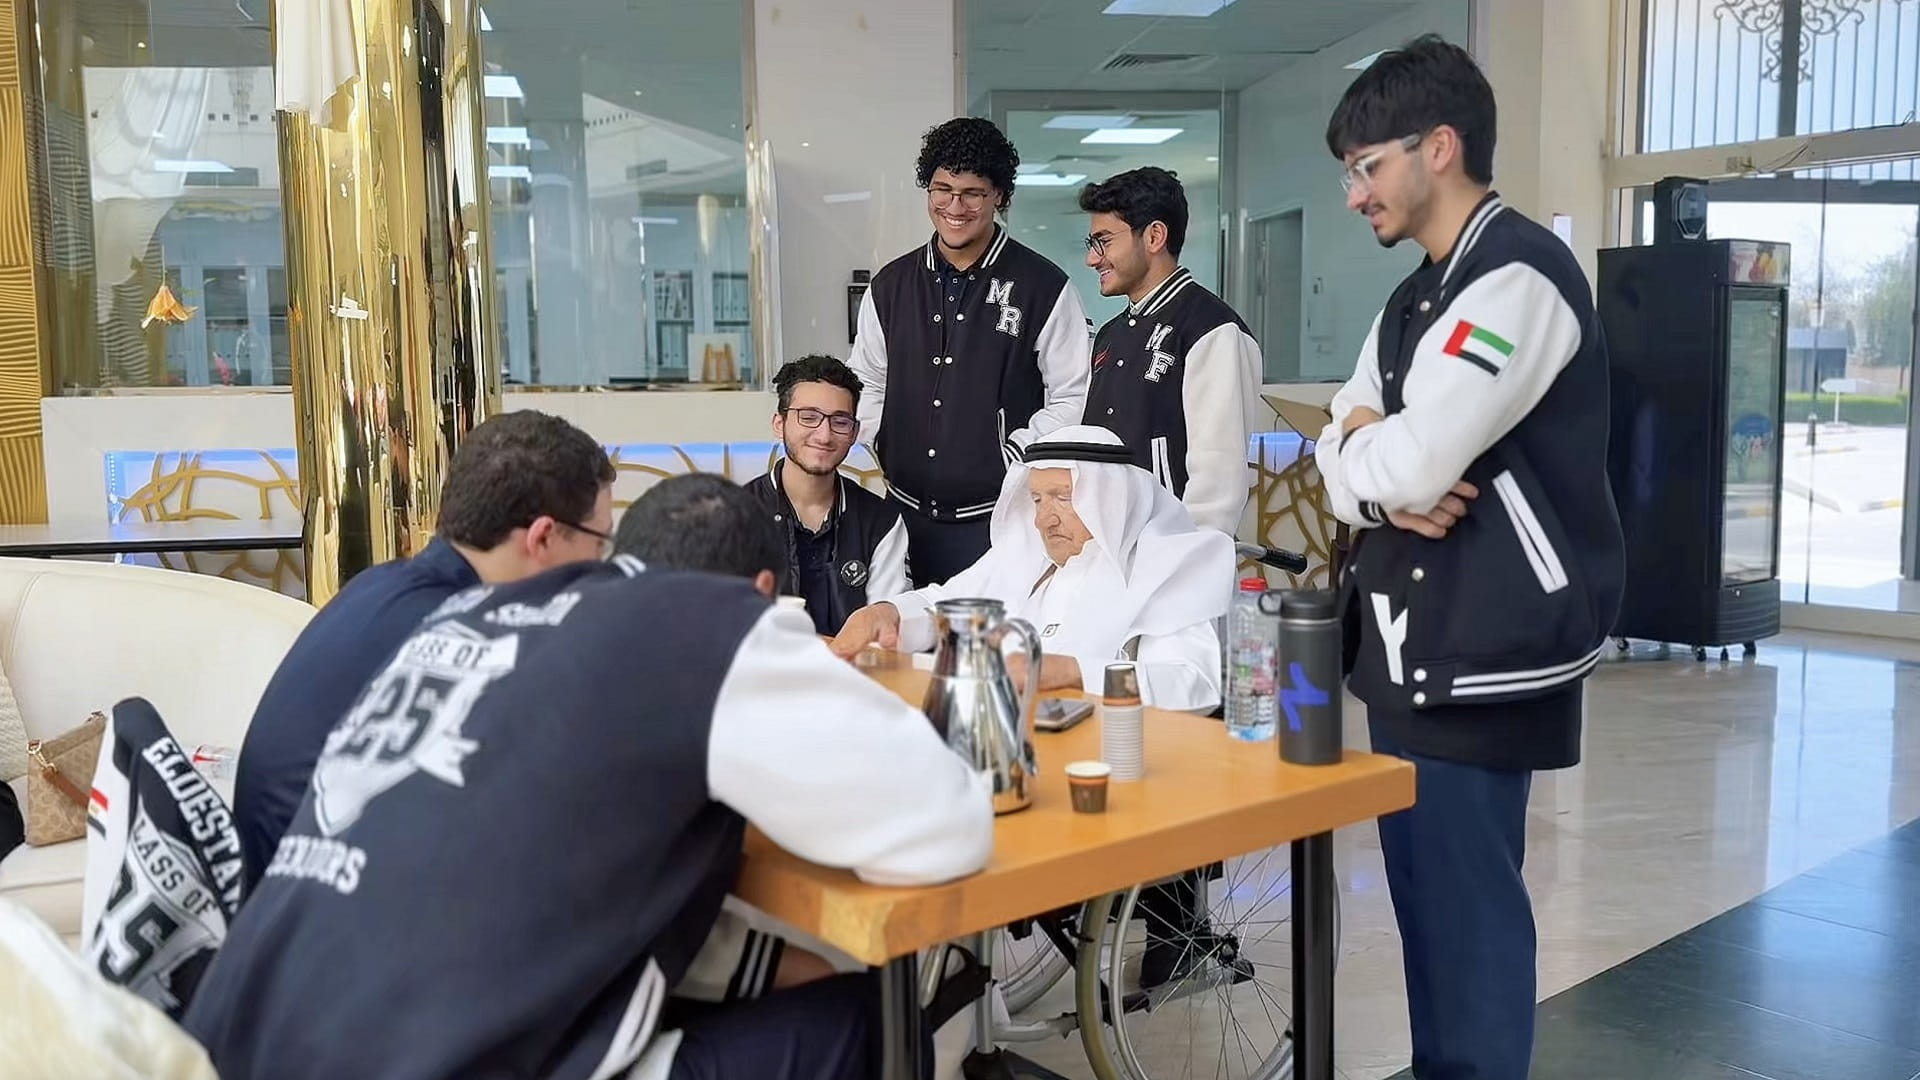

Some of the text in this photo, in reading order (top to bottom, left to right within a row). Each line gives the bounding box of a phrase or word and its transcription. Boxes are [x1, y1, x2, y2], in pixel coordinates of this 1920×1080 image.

[985, 277, 1015, 305] M
[995, 304, 1023, 338] R
[1144, 322, 1174, 351] M
[1144, 350, 1176, 383] F
[1370, 592, 1409, 686] Y
[336, 674, 456, 760] 25
[132, 818, 218, 918] LASS OF
